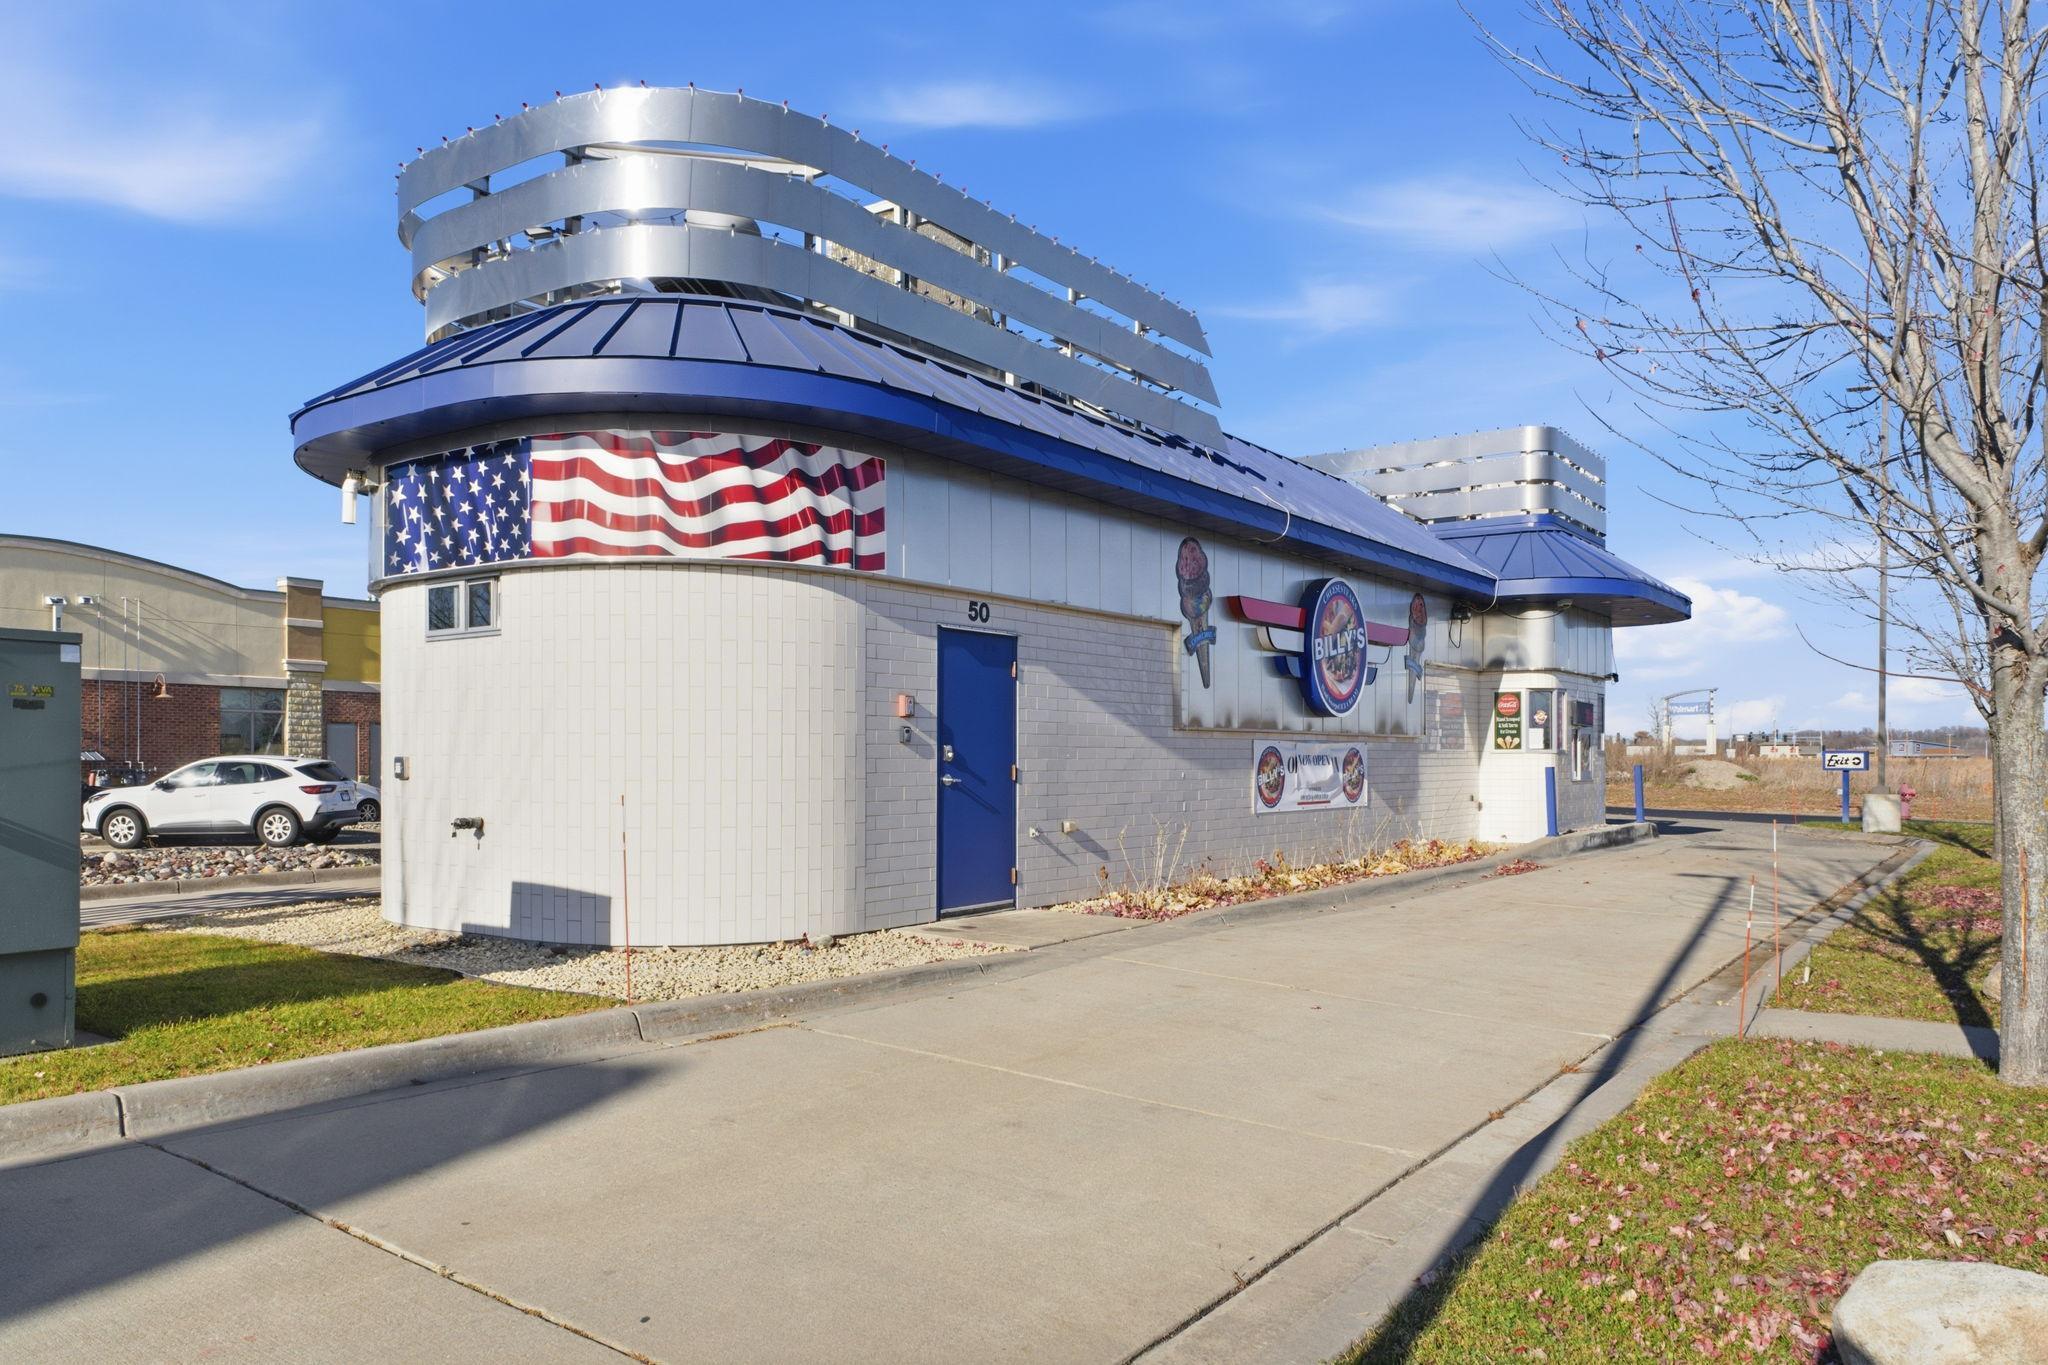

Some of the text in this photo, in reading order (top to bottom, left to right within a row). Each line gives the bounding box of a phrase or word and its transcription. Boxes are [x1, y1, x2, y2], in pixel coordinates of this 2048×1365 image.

[968, 600, 990, 623] 50
[1314, 628, 1365, 661] BILLY'S
[1298, 754, 1312, 766] NOW
[1313, 754, 1330, 766] OPEN
[1827, 755, 1850, 767] Exit
